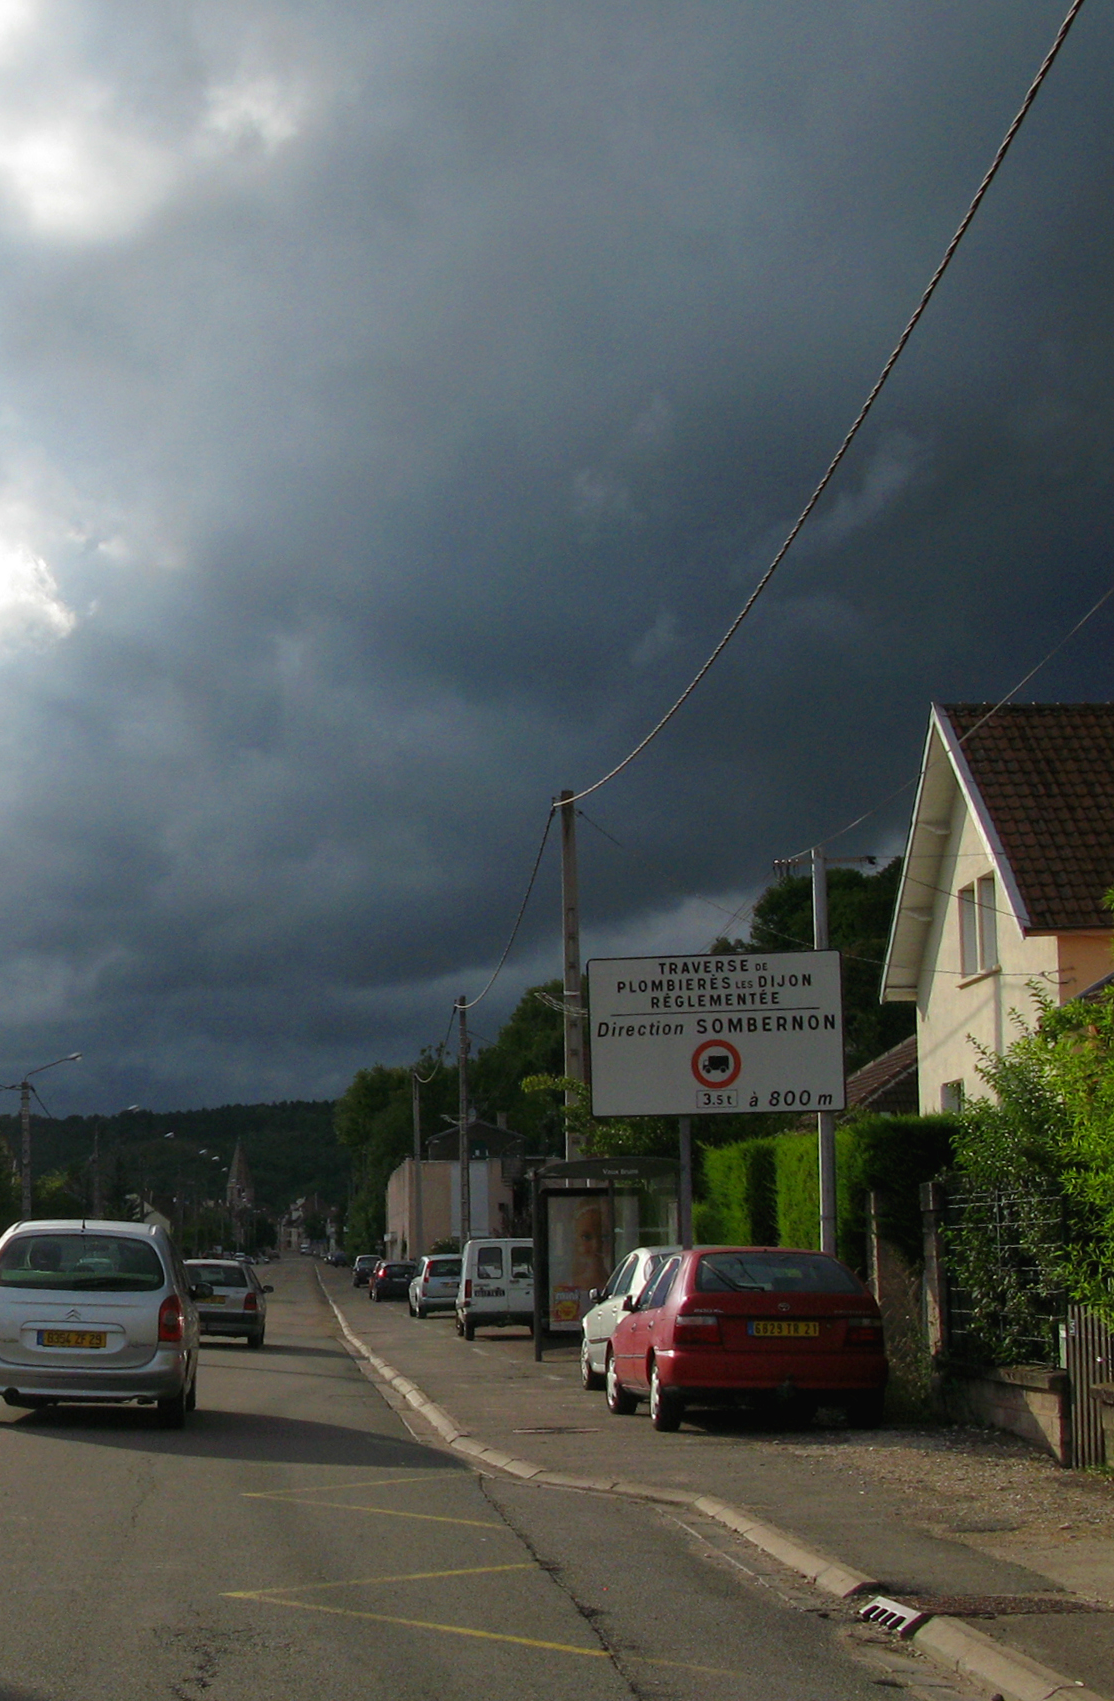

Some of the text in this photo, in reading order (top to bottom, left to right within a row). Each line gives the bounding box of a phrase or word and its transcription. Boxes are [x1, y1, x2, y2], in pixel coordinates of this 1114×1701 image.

[658, 959, 768, 975] TRAVERSE DE
[735, 980, 753, 989] LES
[758, 973, 812, 988] DIJON
[651, 989, 780, 1009] RÉGLEMENTÉE
[597, 1014, 836, 1038] Direction SOMBERNON
[749, 1091, 759, 1107] à
[769, 1090, 811, 1106] 800
[817, 1093, 833, 1105] m
[786, 1323, 799, 1335] TR
[804, 1323, 817, 1335] 21
[89, 1334, 102, 1345] 29
